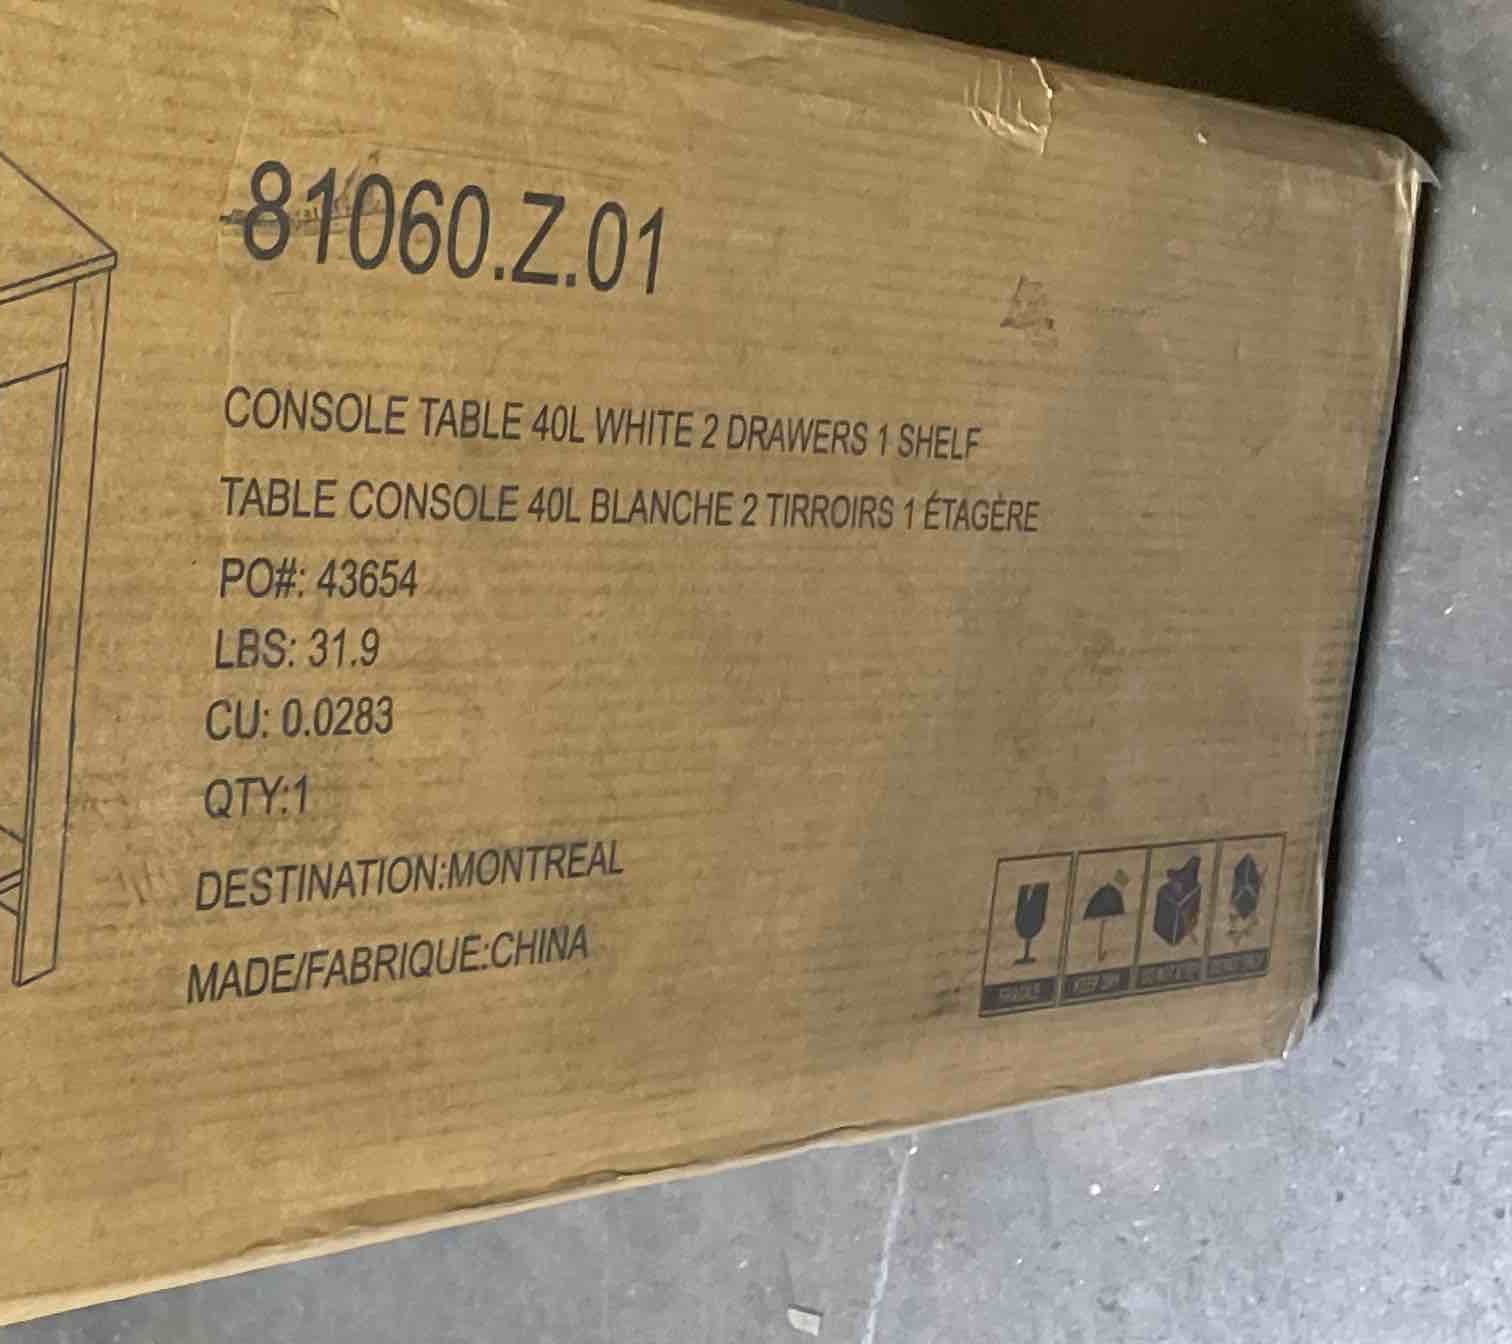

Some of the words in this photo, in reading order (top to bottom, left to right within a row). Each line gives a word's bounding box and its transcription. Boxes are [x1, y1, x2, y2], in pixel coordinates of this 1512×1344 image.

[243, 160, 664, 295] 81060.Z.01
[224, 385, 409, 435] CONSOLE
[419, 396, 524, 441] TABLE
[532, 403, 585, 444] 40L
[595, 406, 694, 449] WHITE
[702, 412, 718, 450] 2
[727, 415, 868, 456] DRAWERS
[878, 421, 888, 457] 1
[897, 423, 981, 460] SHELF
[220, 476, 338, 519] TABLE
[349, 479, 520, 522] CONSOLE
[527, 485, 581, 524] 40L
[590, 487, 734, 527] BLANCHE
[740, 495, 758, 527] 2
[767, 492, 894, 529] TIRROIRS
[904, 498, 915, 530] 1
[220, 557, 305, 599] PO#:
[317, 558, 418, 599] 43654
[215, 627, 296, 669] LBS:
[308, 626, 381, 668] 31.9
[205, 698, 271, 741] CU:
[282, 695, 394, 737] 0.0283
[203, 773, 308, 819] QTY:1
[195, 839, 625, 911] DESTINATION:MONTREAL
[187, 923, 590, 1004] MADE/FABRIQUE:CHINA
